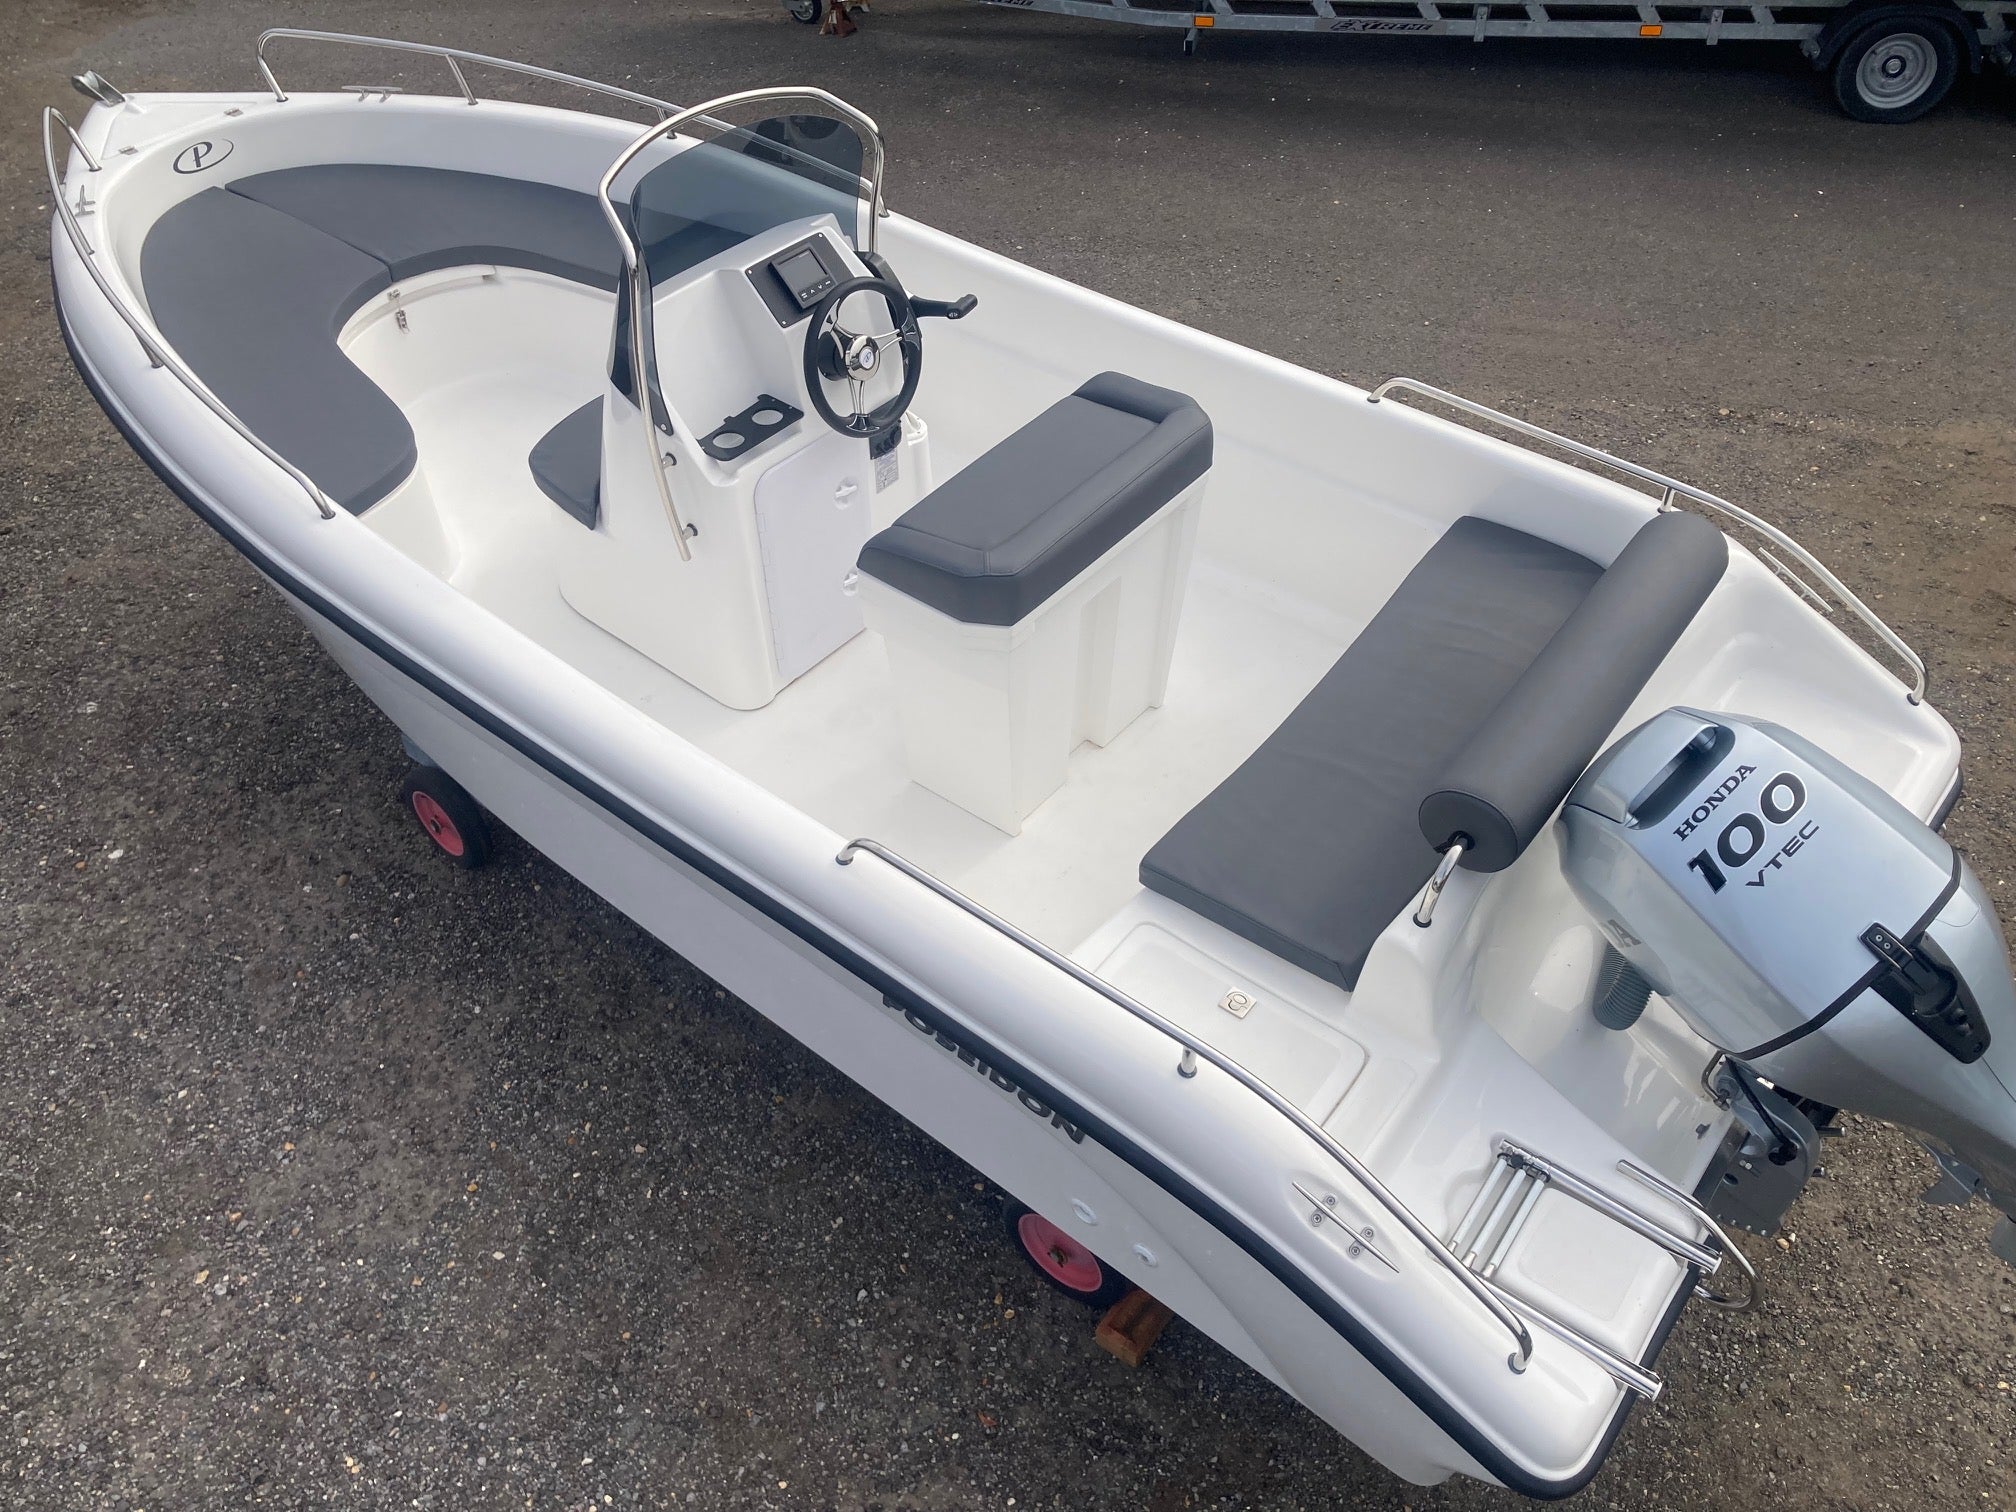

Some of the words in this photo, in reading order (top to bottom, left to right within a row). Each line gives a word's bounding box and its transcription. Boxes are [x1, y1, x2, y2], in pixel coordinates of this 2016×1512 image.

[1330, 18, 1434, 32] EXTREME
[1672, 764, 1758, 842] HONDA
[1686, 770, 1808, 895] 100
[1745, 820, 1820, 887] VTEC
